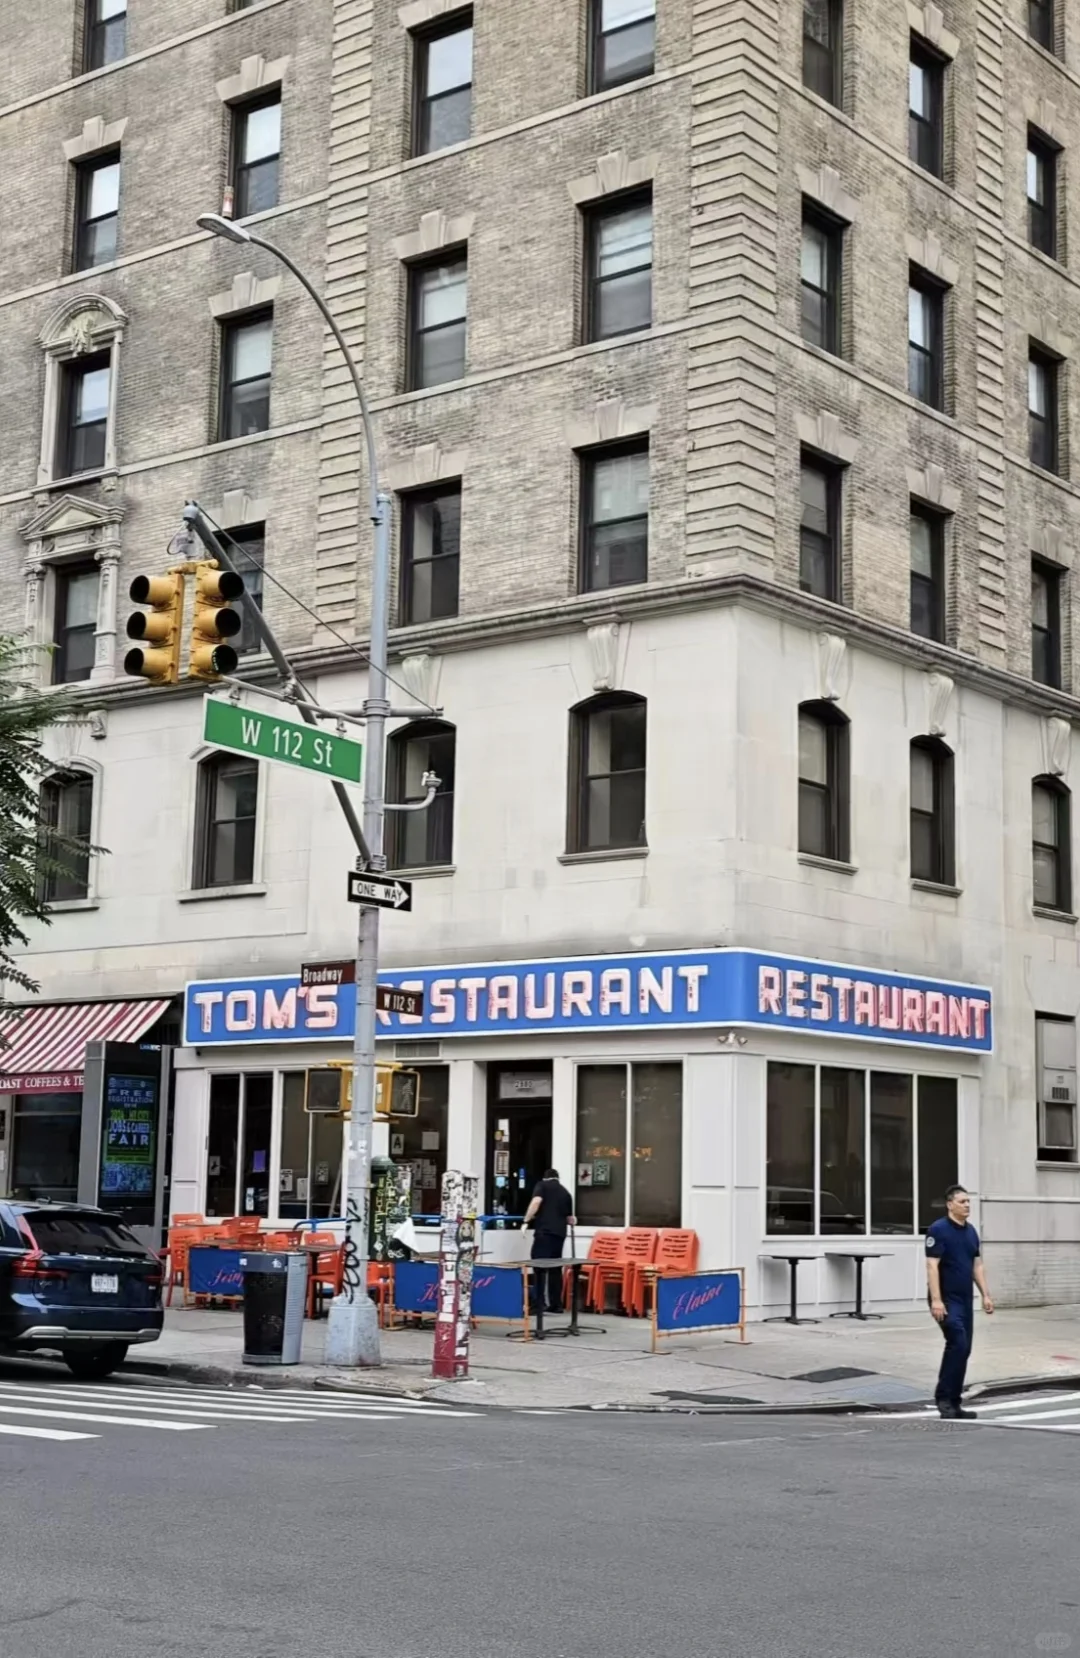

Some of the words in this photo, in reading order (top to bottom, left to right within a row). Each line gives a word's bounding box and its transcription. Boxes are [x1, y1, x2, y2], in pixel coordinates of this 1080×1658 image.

[241, 716, 261, 747] W
[272, 726, 303, 759] 112
[312, 738, 333, 768] St
[356, 882, 376, 897] ONE
[383, 885, 403, 902] WAY
[303, 968, 343, 984] Broadway
[193, 984, 339, 1033] TOM'S
[383, 993, 391, 1008] W
[393, 995, 405, 1011] 112
[406, 997, 416, 1013] St
[757, 965, 990, 1040] RESTAURANT
[25, 1076, 61, 1088] COFFEES
[63, 1076, 71, 1087] &
[108, 1089, 153, 1097] FREE
[108, 1134, 149, 1145] FAIR
[393, 1136, 402, 1149] A
[416, 1275, 496, 1302] Ker
[672, 1282, 724, 1321] Elaine
